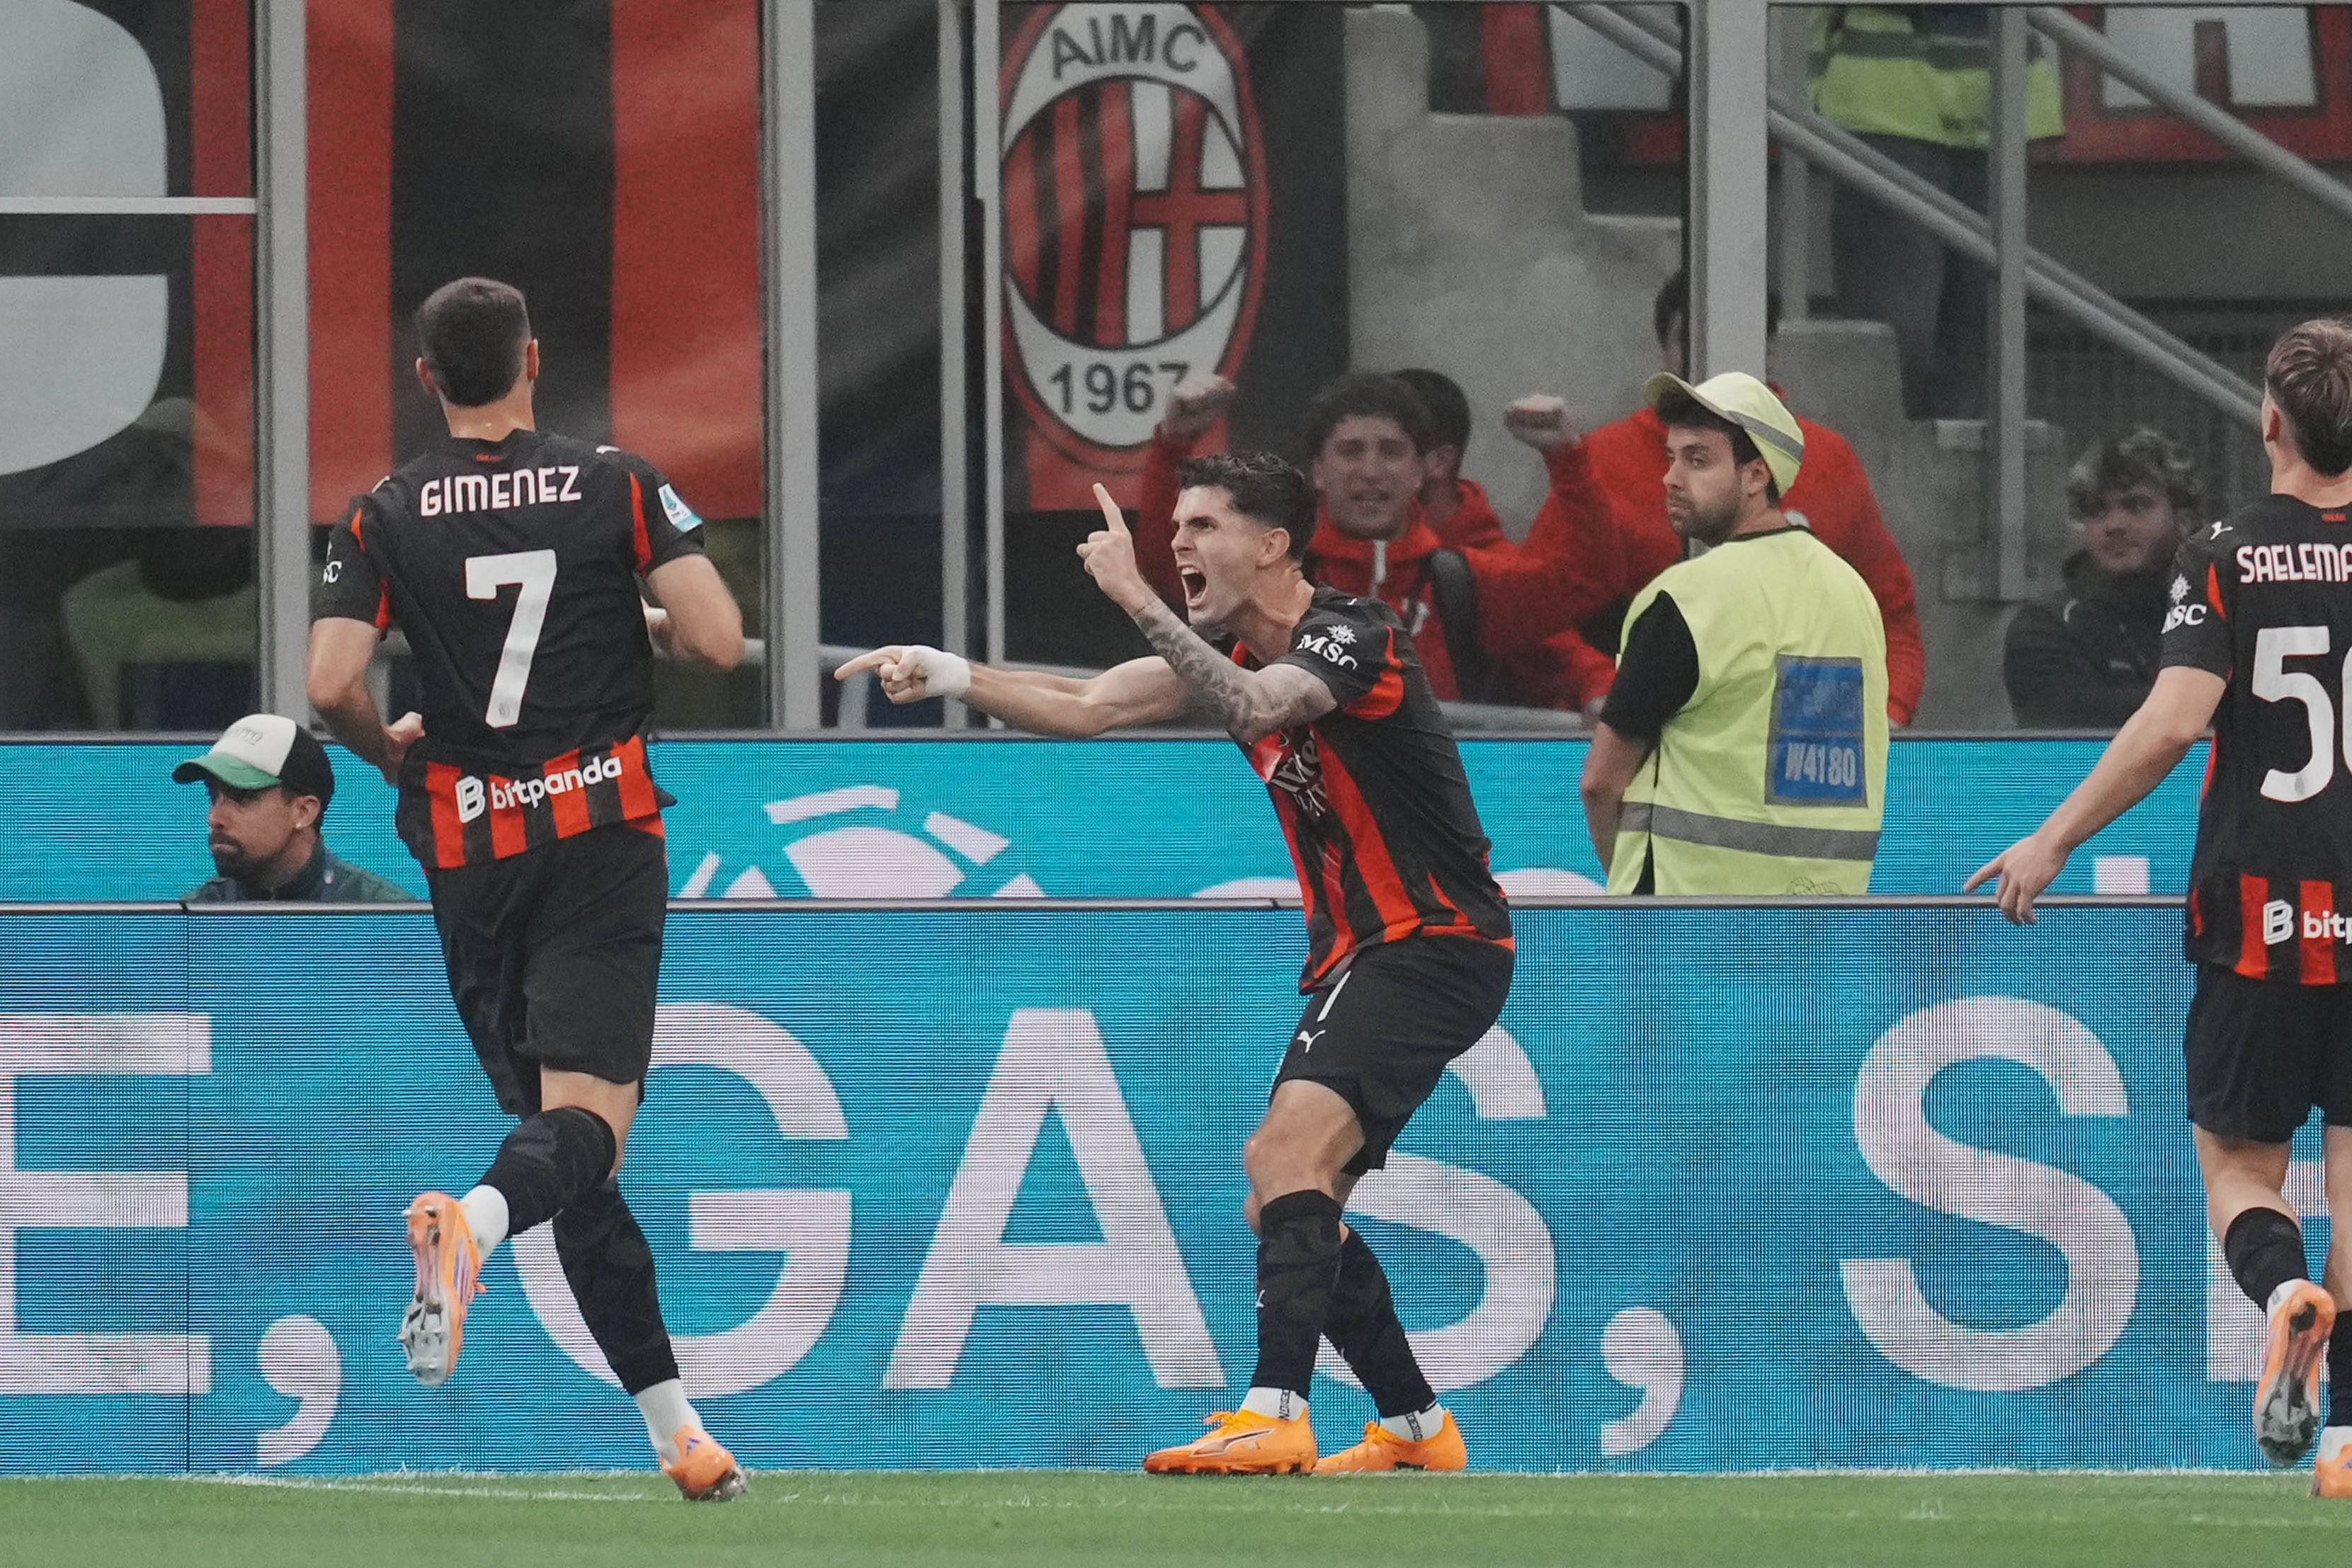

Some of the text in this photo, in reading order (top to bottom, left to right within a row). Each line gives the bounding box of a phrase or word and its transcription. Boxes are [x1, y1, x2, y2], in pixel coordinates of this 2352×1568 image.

[1051, 13, 1205, 80] AIMC
[420, 465, 582, 517] GIMENEZ
[465, 548, 558, 729] 7
[2251, 625, 2352, 803] 5
[489, 755, 623, 810] bitpanda
[1785, 742, 1856, 788] W4180
[511, 1000, 1685, 1457] GAS,
